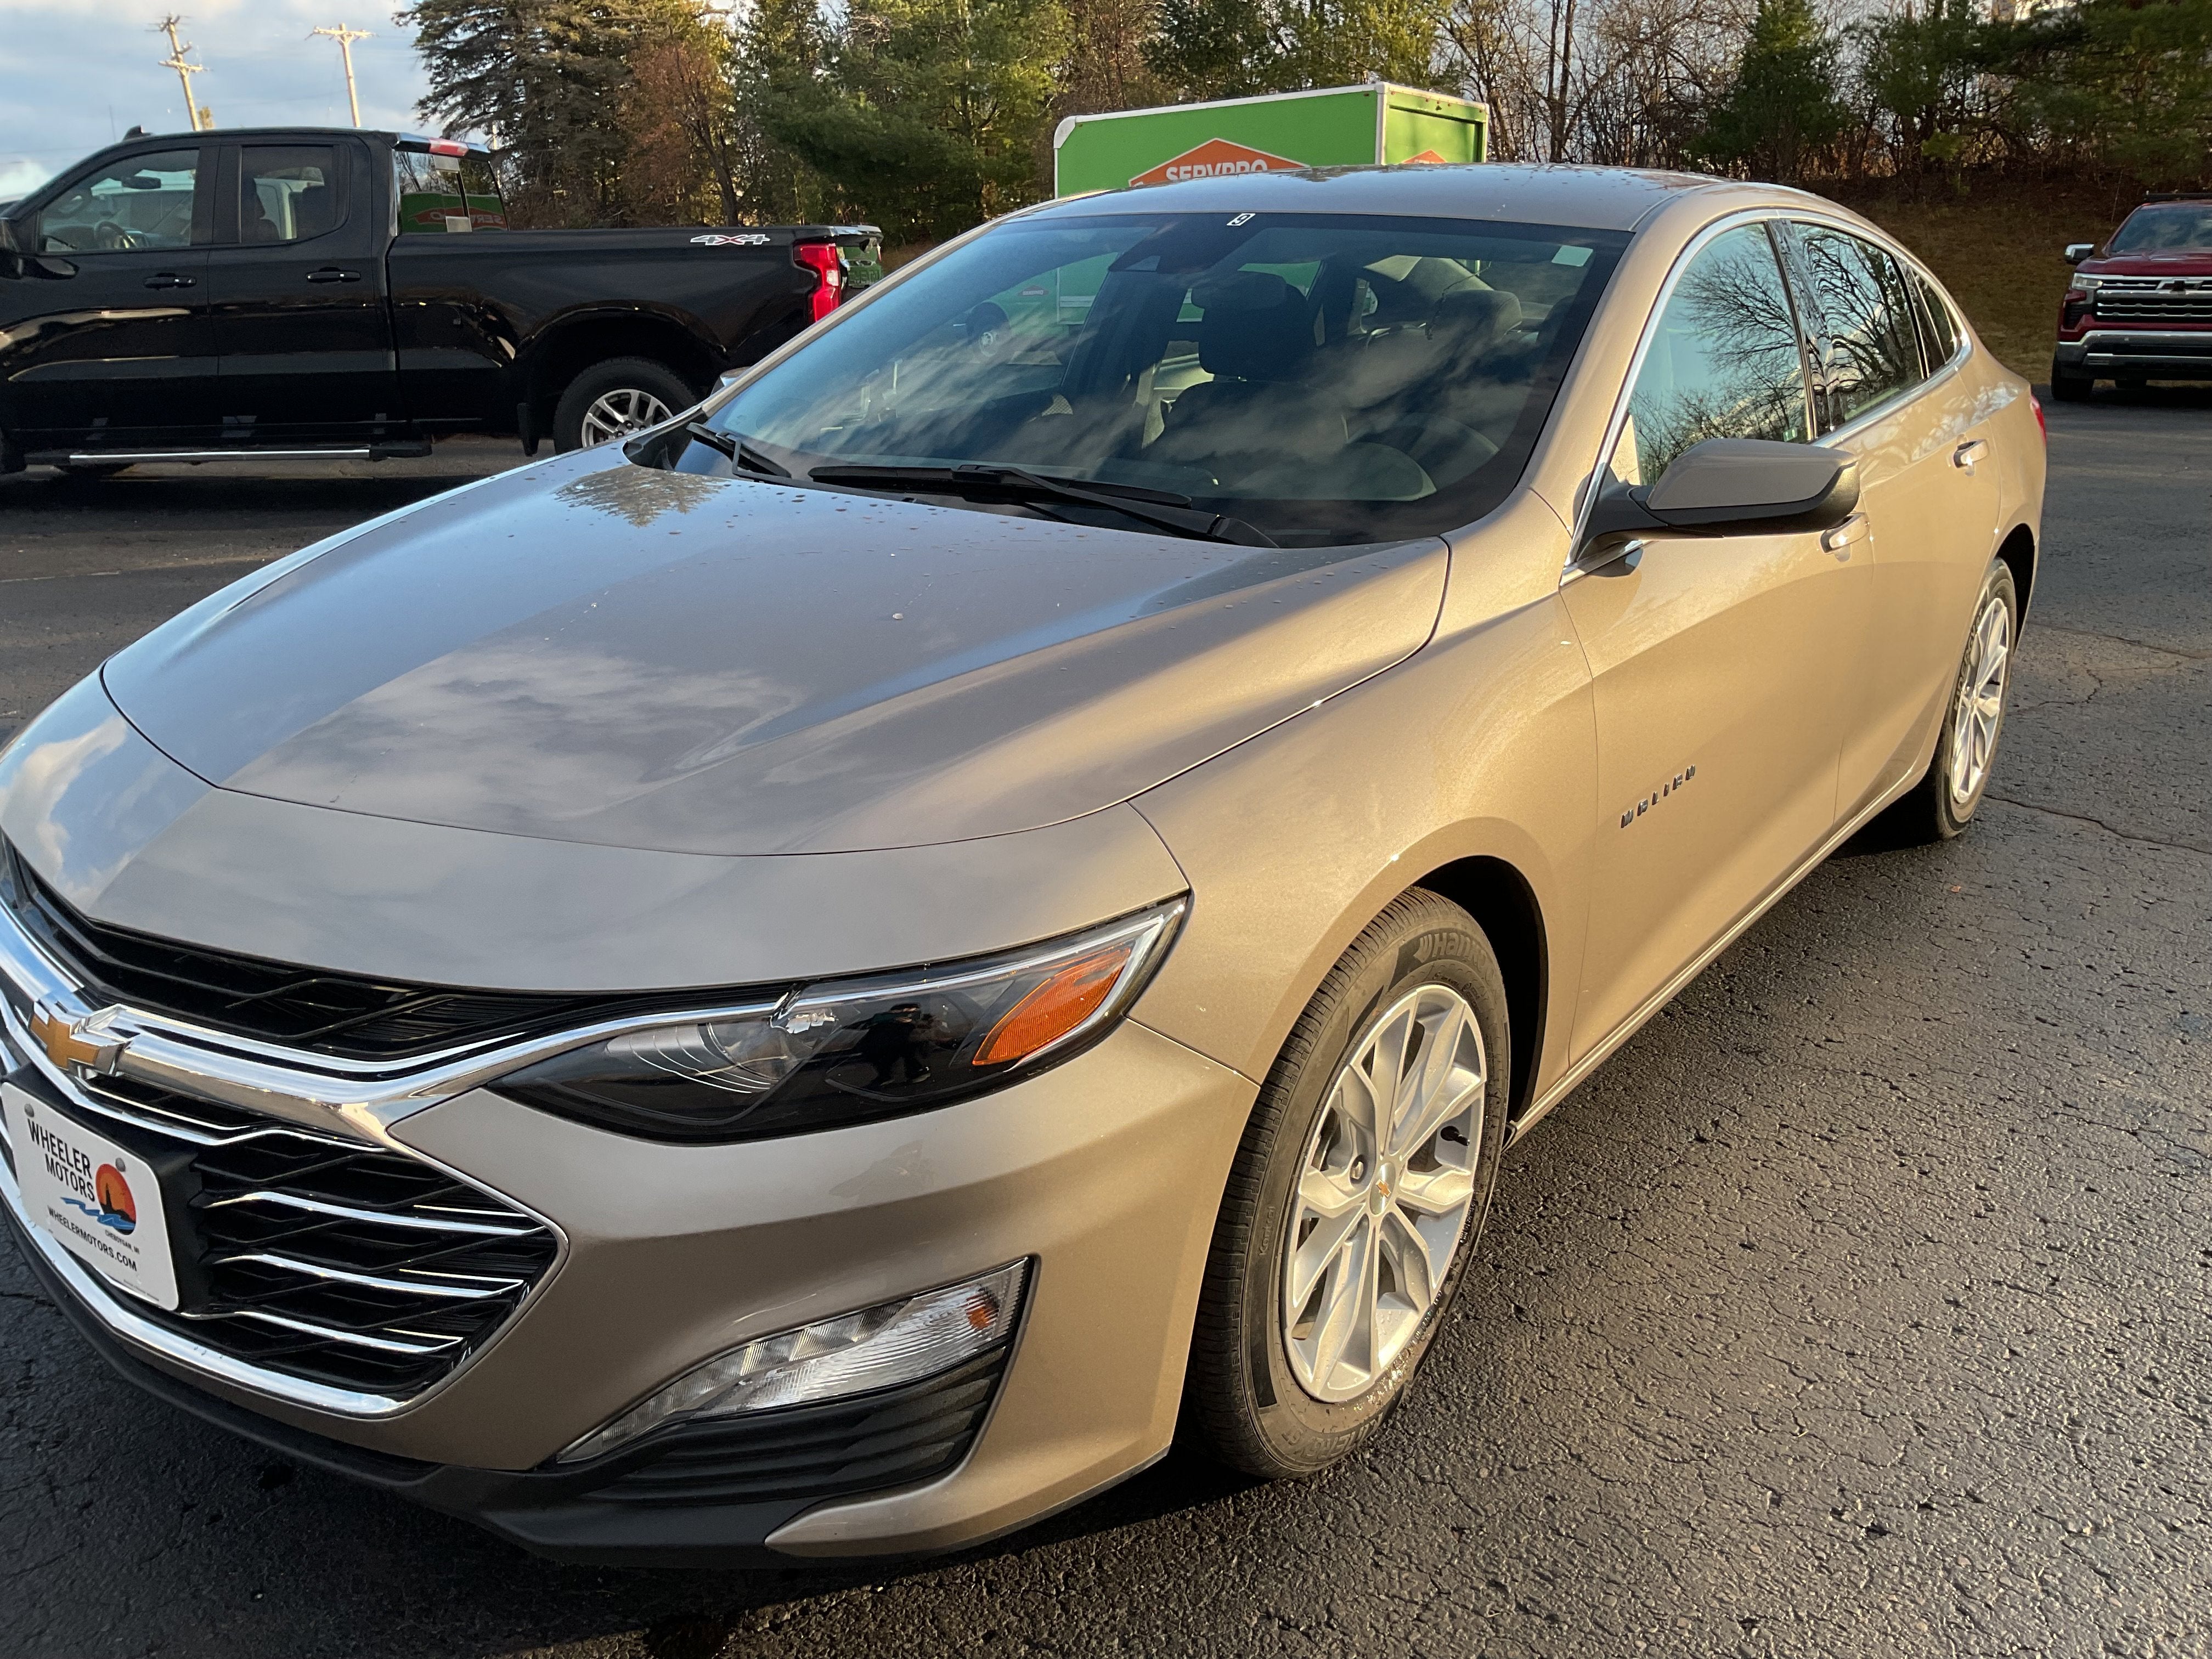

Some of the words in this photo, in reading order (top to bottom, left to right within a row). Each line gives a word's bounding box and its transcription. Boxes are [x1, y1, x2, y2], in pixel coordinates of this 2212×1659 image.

[1621, 764, 1696, 828] MALIBU
[27, 1118, 92, 1179] WHEELER
[45, 1154, 95, 1201] MOTORS
[48, 1205, 137, 1272] WHEELERMOTORS.COM
[1259, 1206, 1276, 1256] Kontrol
